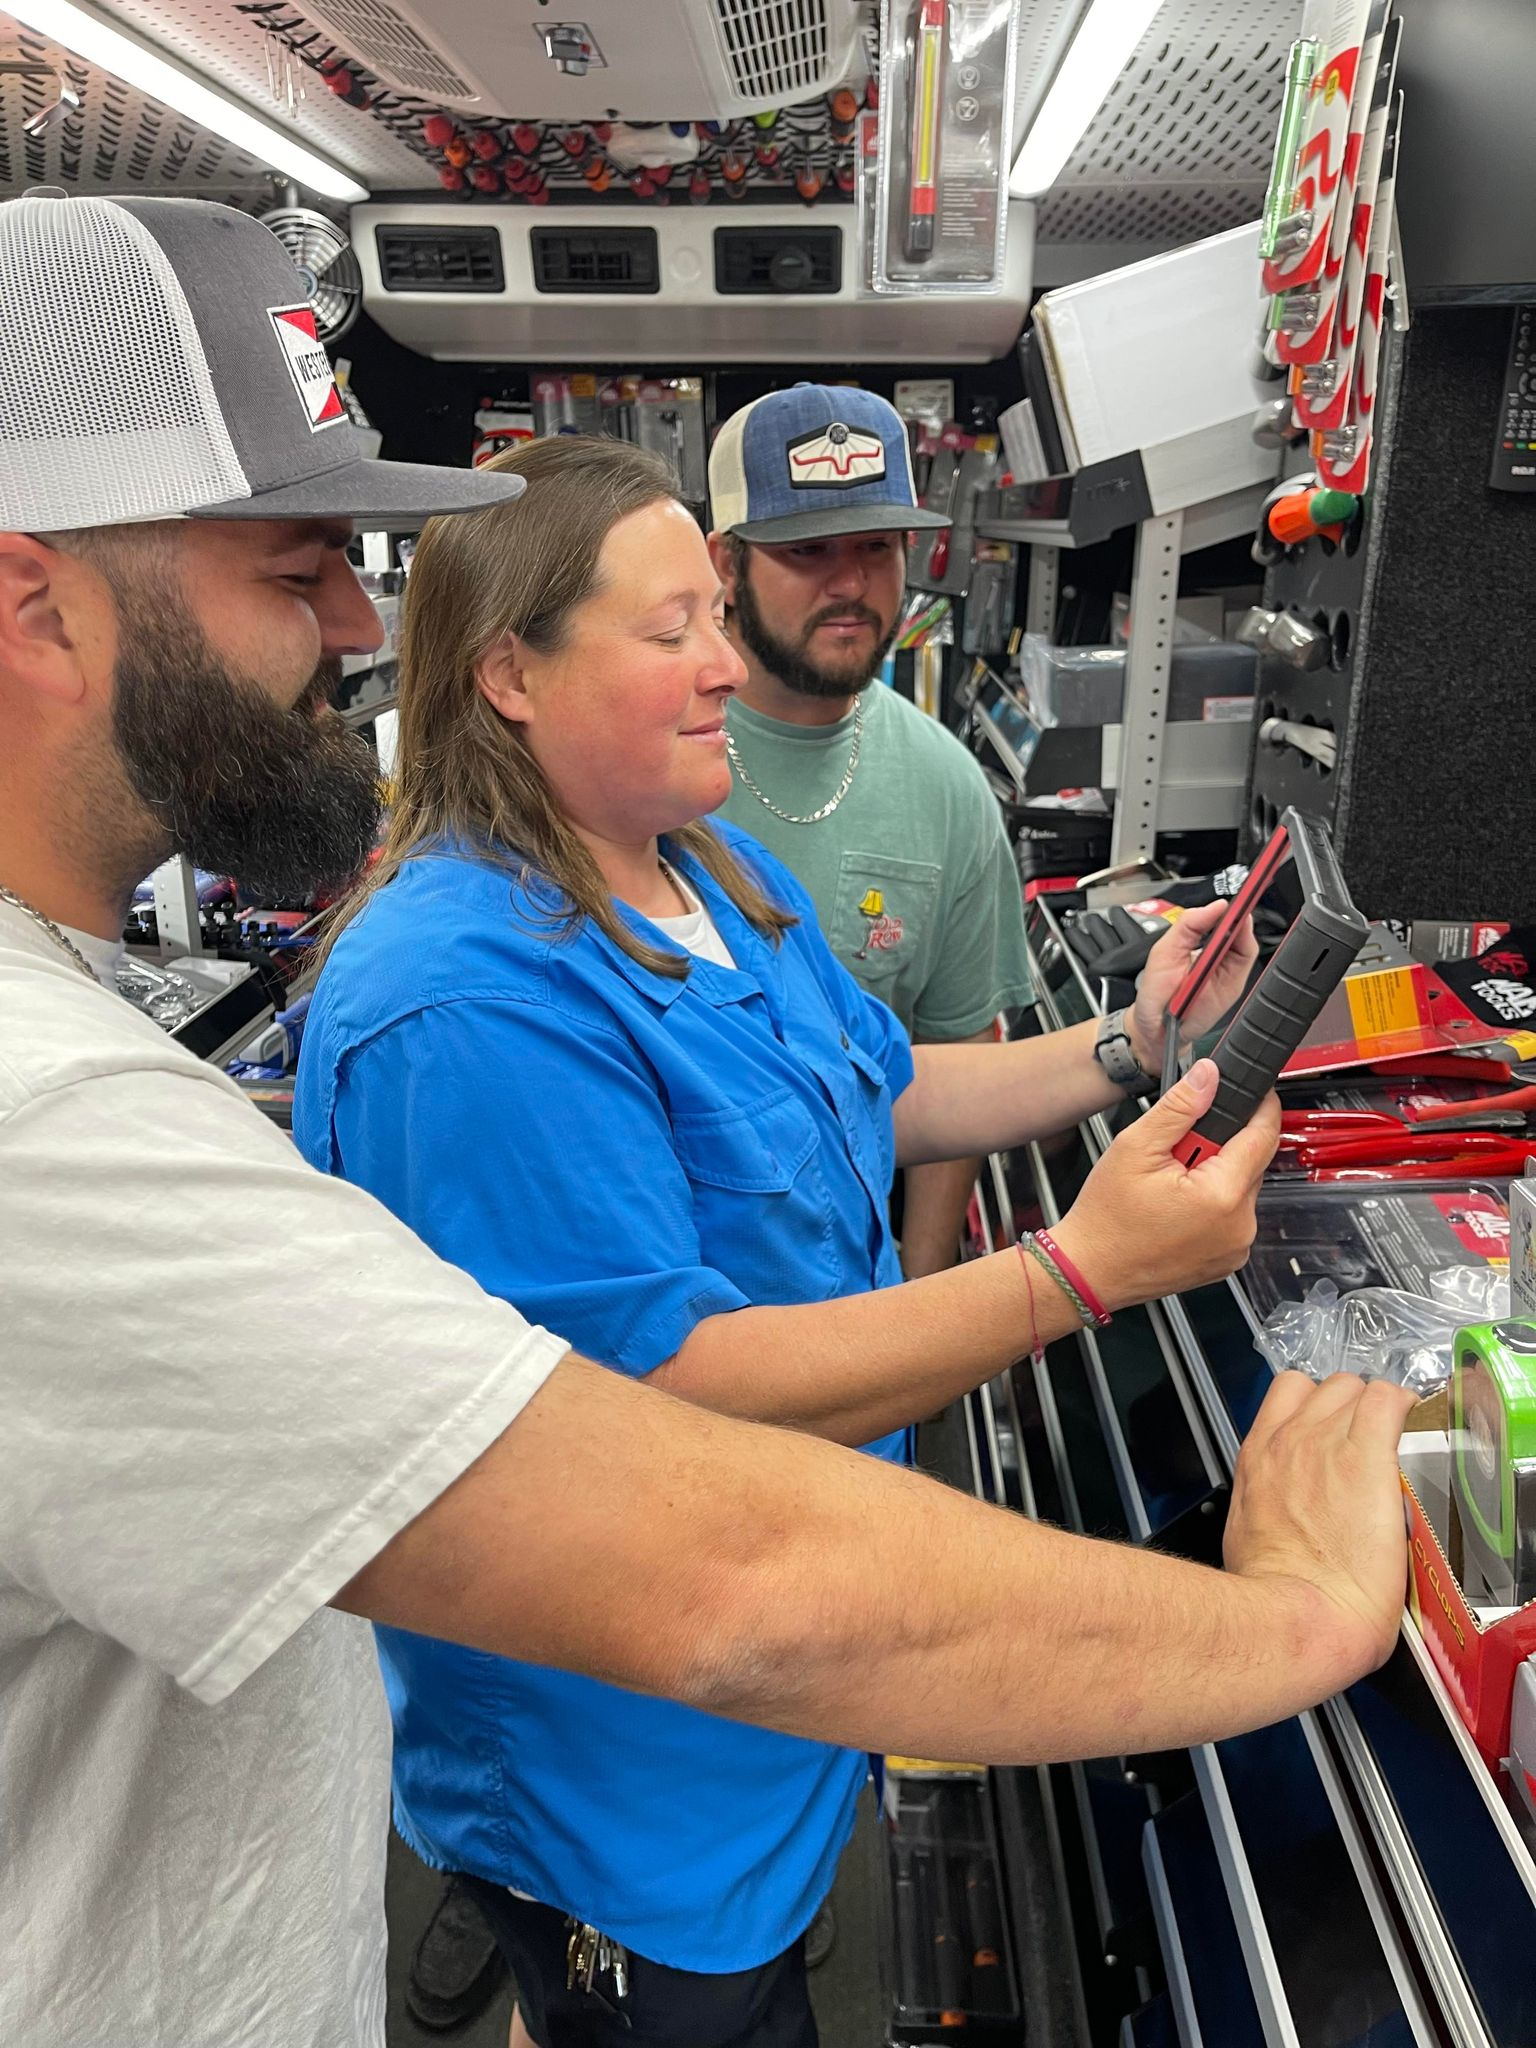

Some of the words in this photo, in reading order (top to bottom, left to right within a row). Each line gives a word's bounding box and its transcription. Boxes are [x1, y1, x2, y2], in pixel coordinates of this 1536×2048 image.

[1470, 980, 1521, 1021] TOOLS
[1486, 978, 1536, 1018] MAC
[1414, 1537, 1466, 1649] CYCLOPS
